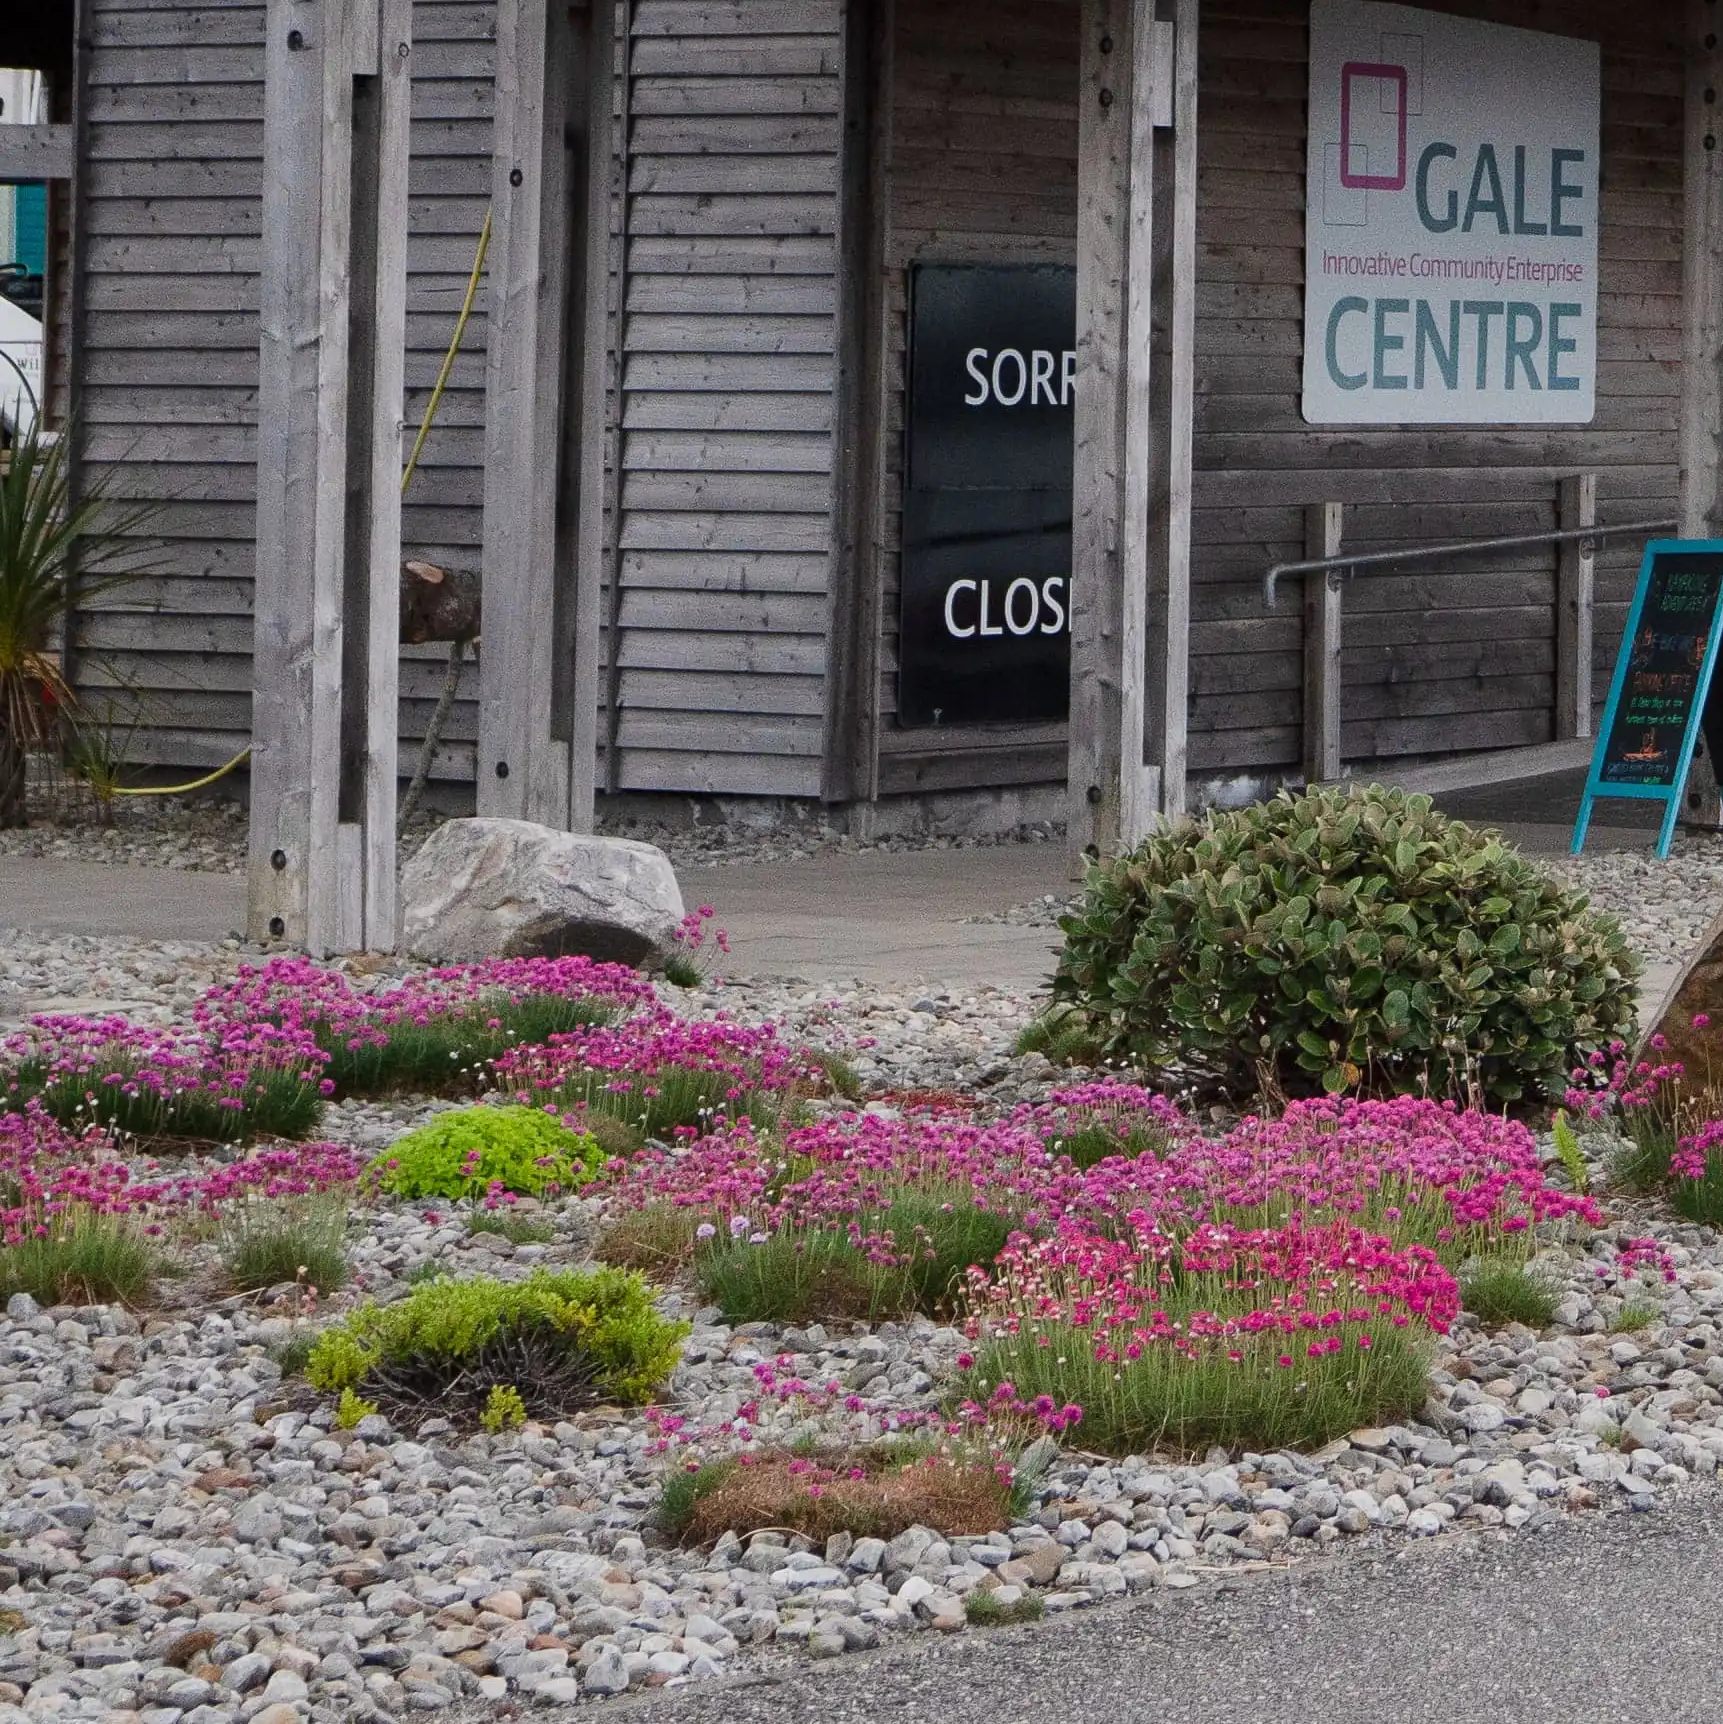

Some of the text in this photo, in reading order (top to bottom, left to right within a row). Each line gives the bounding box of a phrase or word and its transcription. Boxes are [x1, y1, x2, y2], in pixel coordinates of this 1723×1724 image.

[1415, 142, 1585, 237] GALE
[1323, 250, 1584, 287] Innovative Community Enterprise
[1324, 295, 1583, 391] CENTRE
